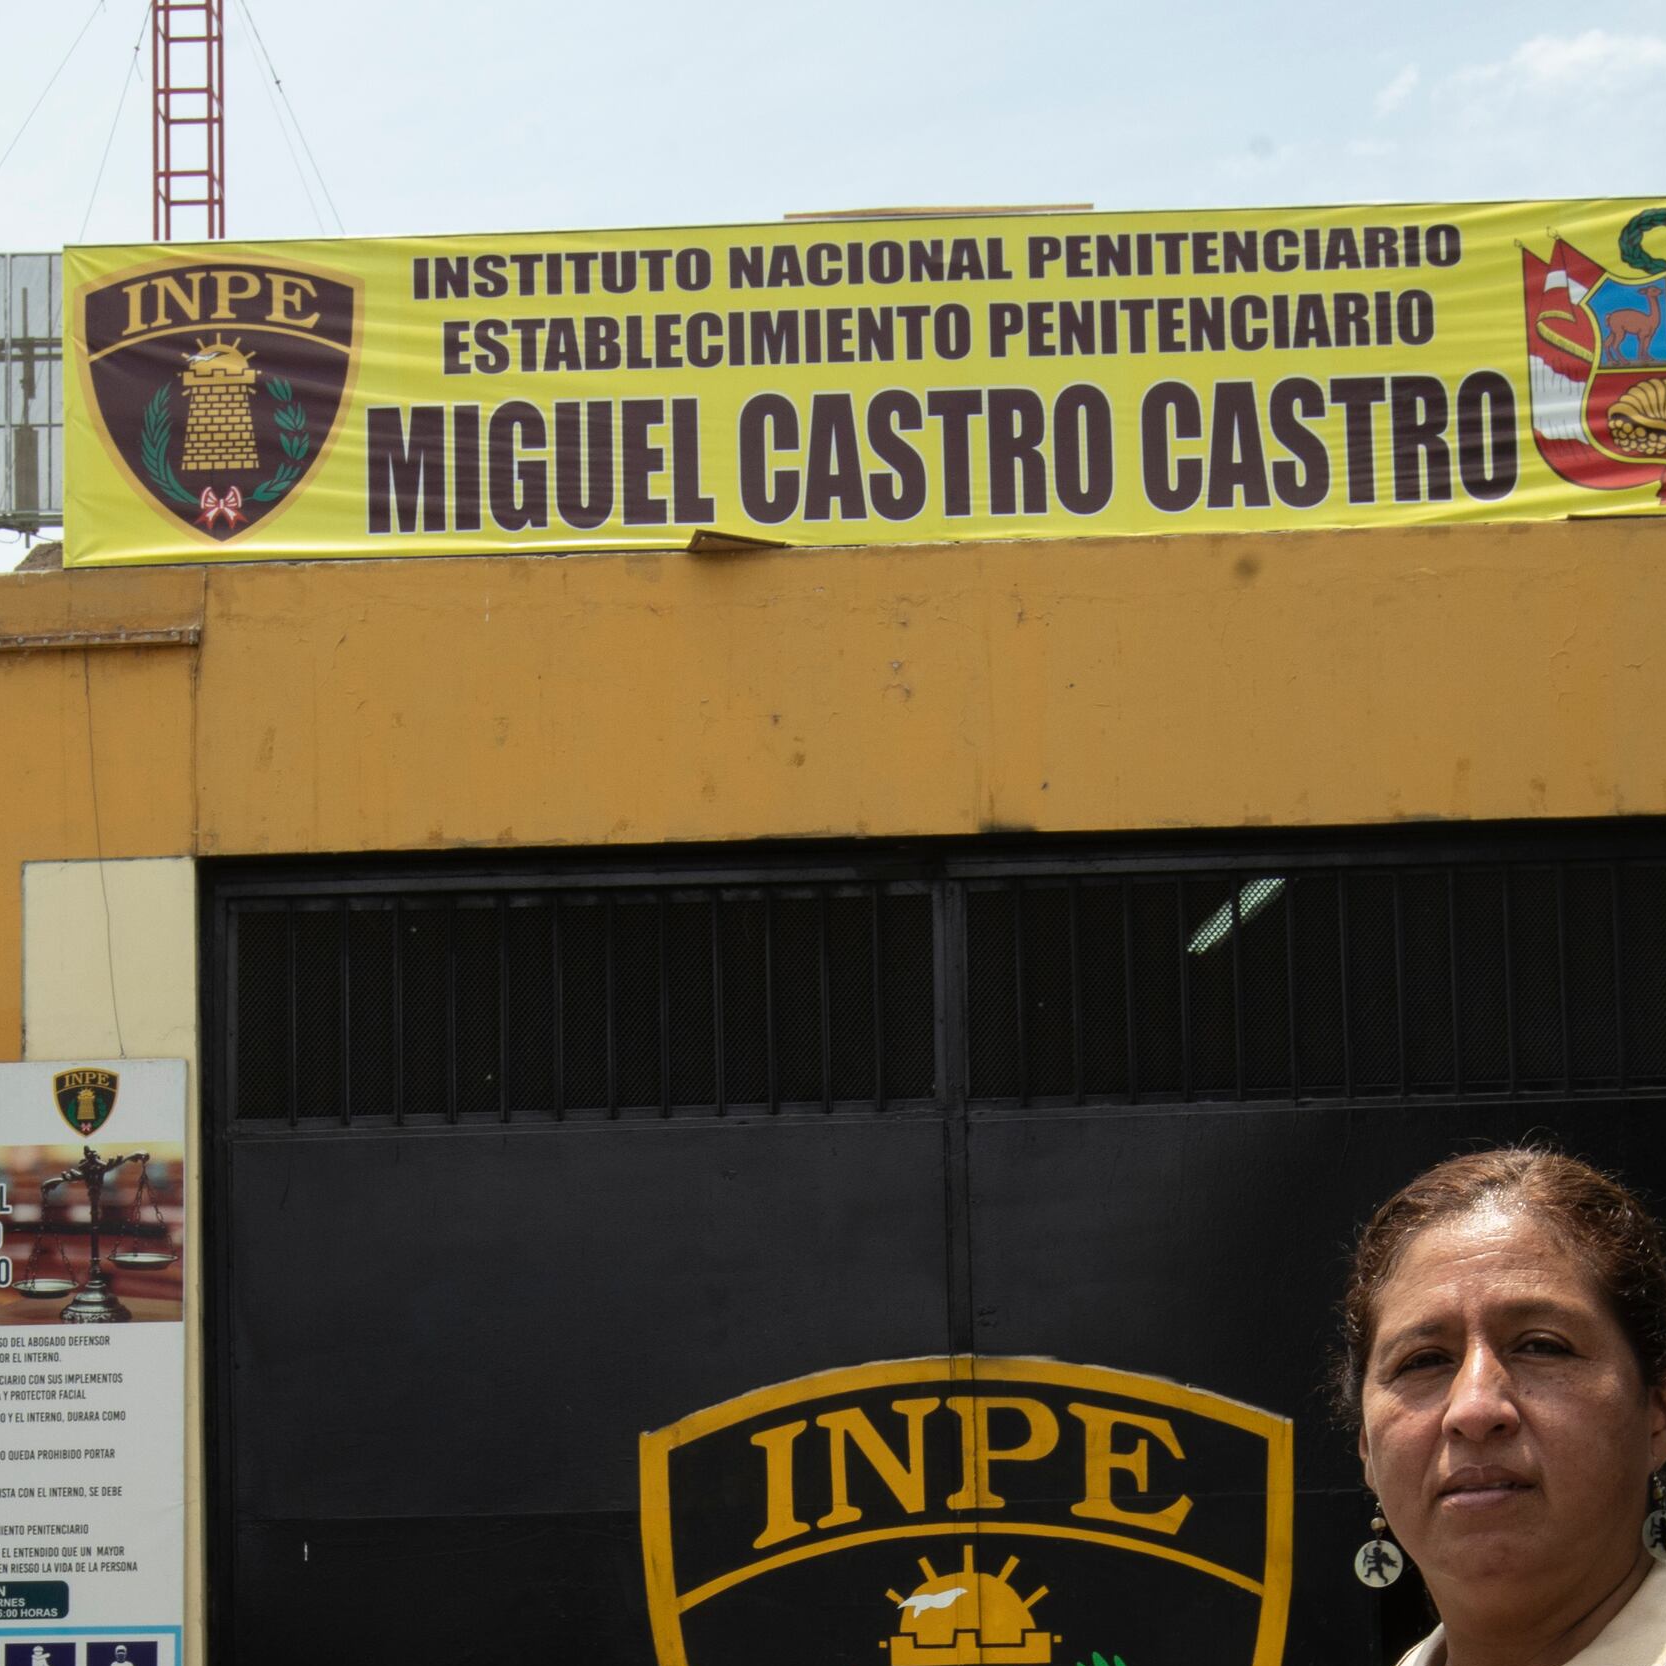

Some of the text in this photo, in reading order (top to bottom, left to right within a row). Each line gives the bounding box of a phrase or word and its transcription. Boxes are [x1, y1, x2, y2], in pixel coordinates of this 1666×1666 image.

[413, 224, 1461, 300] INSTITUTO NACIONAL PENITENCIARIO
[122, 270, 322, 337] INPE
[443, 289, 1434, 375] ESTABLECIMIENTO PENITENCIARIO
[368, 367, 1517, 535] MIGUEL CASTRO CASTRO
[63, 1071, 111, 1090] INPE
[750, 1396, 1195, 1551] INPE
[27, 1524, 89, 1535] PENITENCIARIO
[20, 1607, 58, 1619] HORAS
